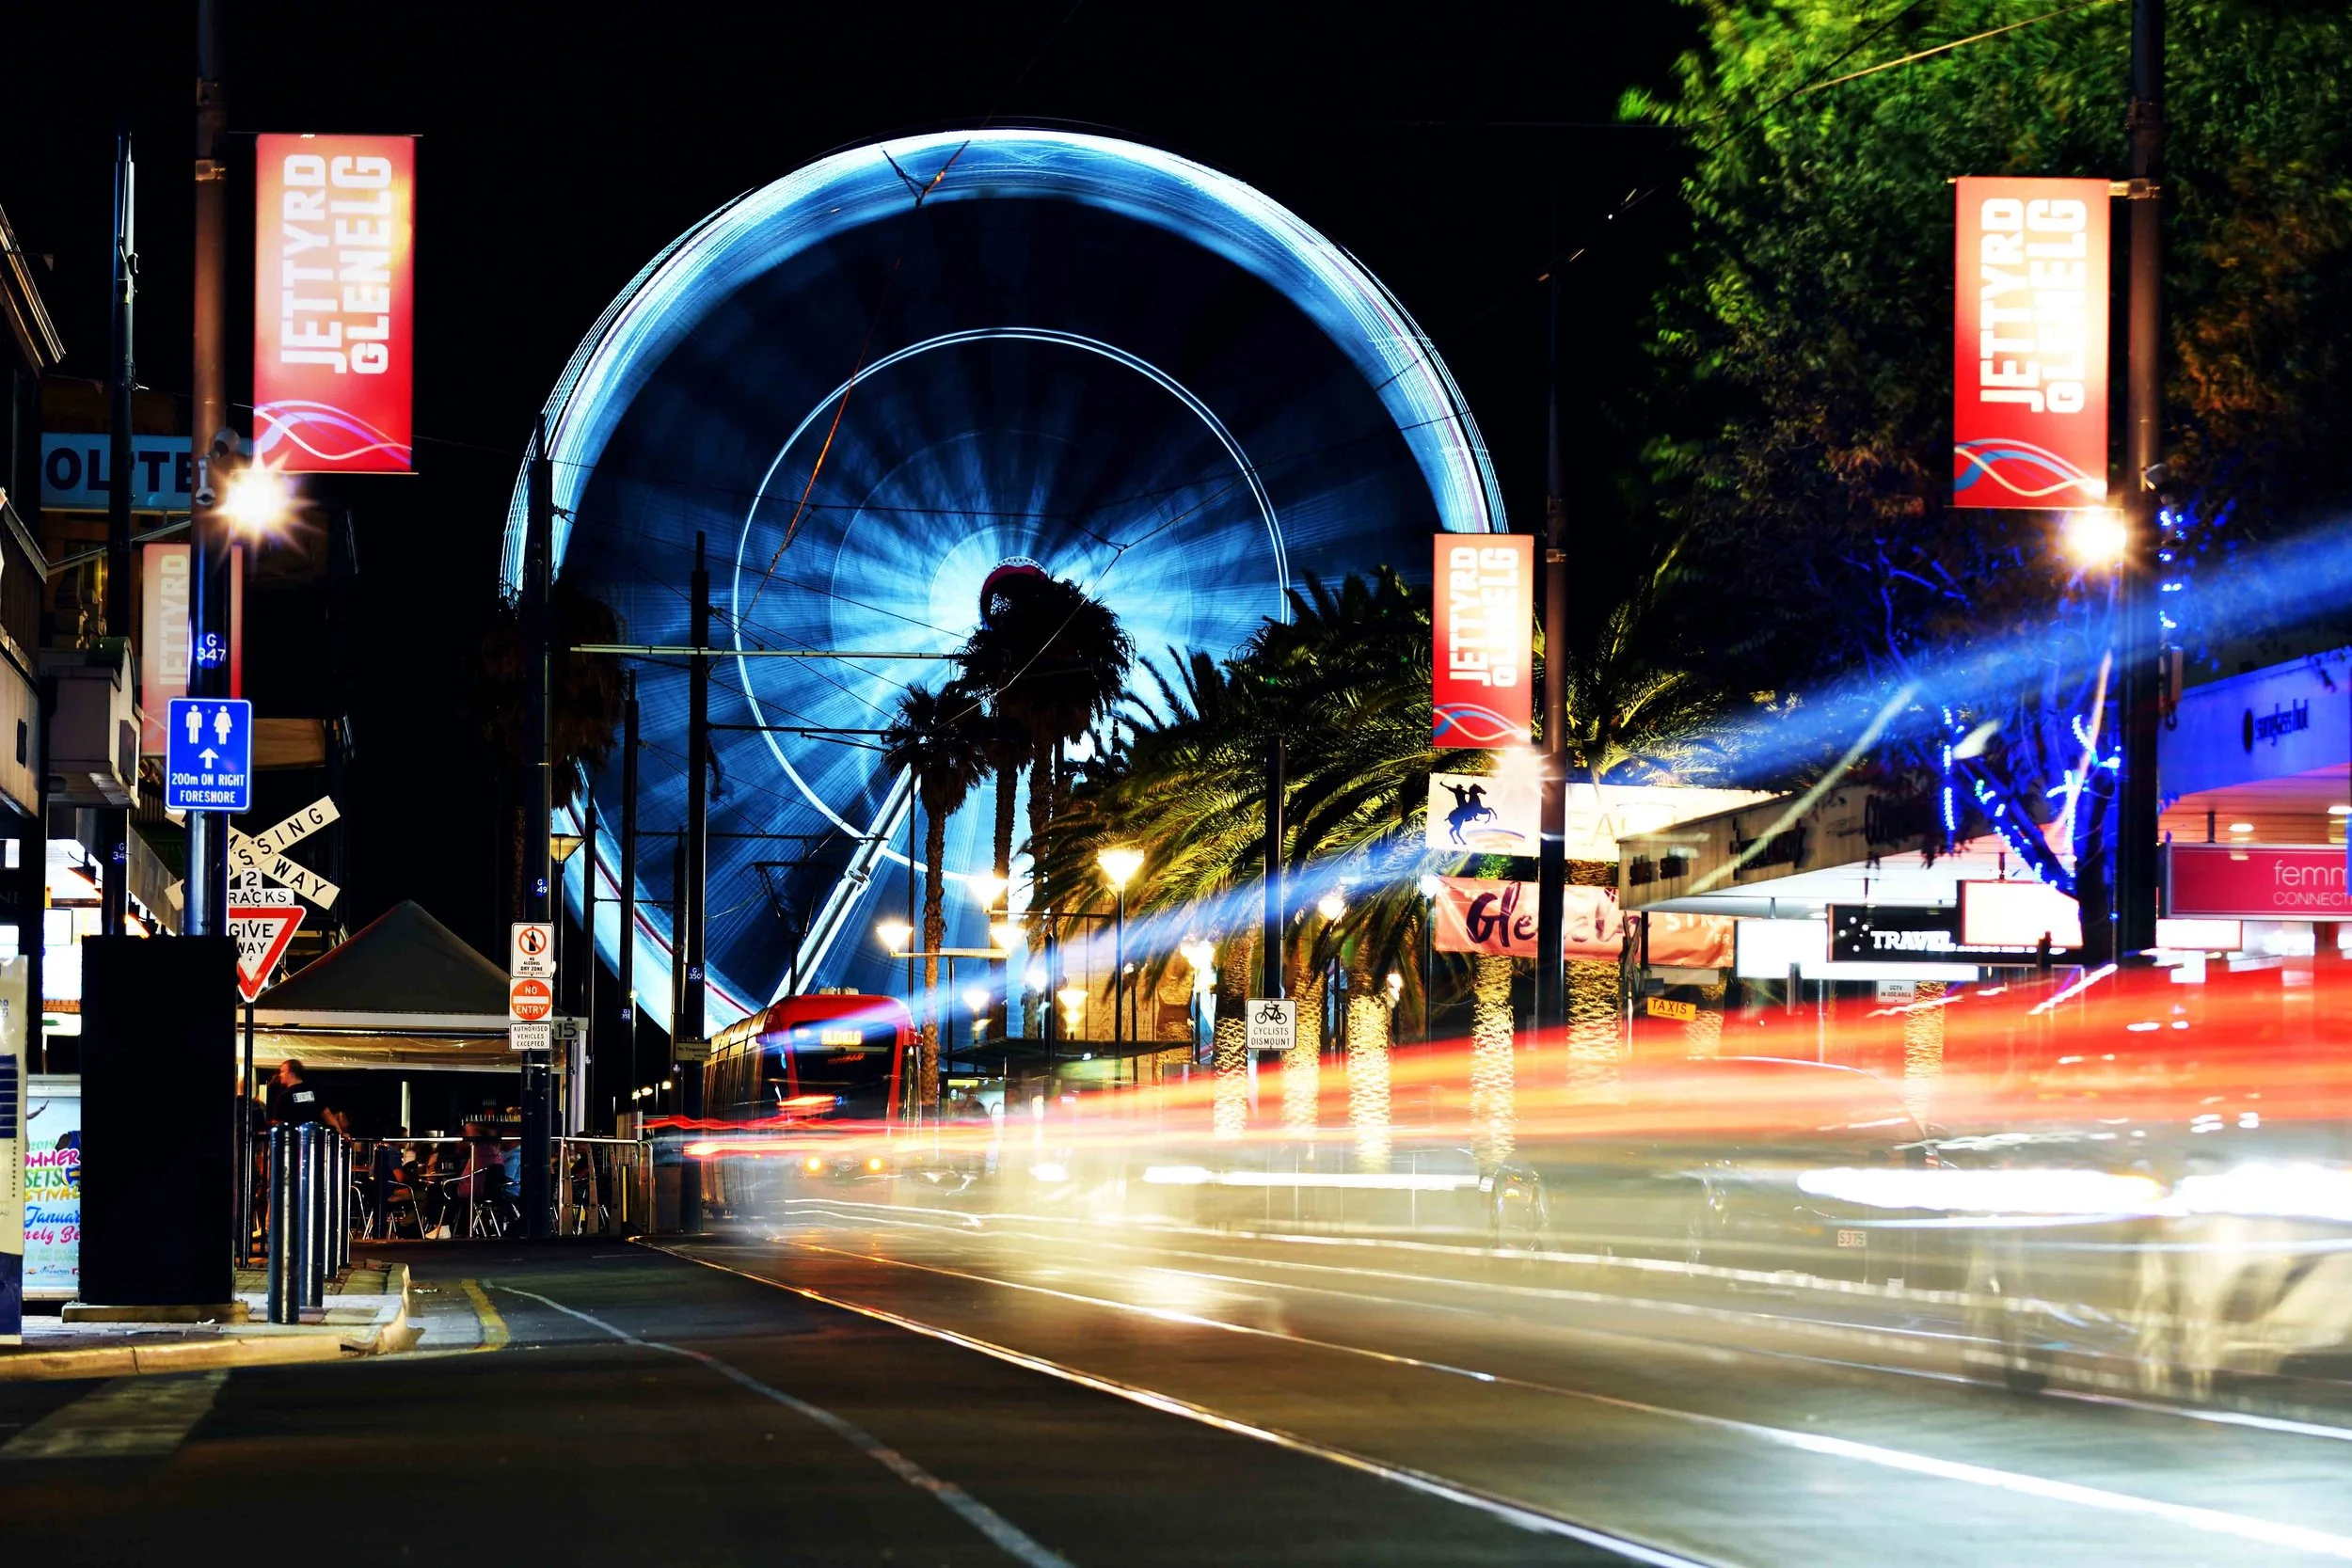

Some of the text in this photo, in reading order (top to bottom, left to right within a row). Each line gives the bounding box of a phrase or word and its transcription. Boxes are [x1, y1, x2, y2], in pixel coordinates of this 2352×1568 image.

[330, 156, 391, 374] GLENELG
[2026, 198, 2086, 413] GLENELG
[1479, 548, 1518, 687] GLELG
[206, 634, 217, 646] G
[197, 647, 226, 661] 347
[171, 773, 245, 786] 200m ON RIGHT
[180, 790, 235, 803] FORESHORE
[246, 871, 257, 886] 2
[229, 923, 274, 938] GIVE
[236, 942, 266, 954] WAY
[1870, 931, 1956, 952] TRAVEL
[525, 986, 538, 994] NO
[516, 1006, 545, 1014] ENTRY
[1652, 999, 1687, 1014] TAXIS
[557, 1022, 577, 1037] 15
[1253, 1027, 1289, 1036] CYCLISTS
[1250, 1037, 1291, 1046] DISMOUNT
